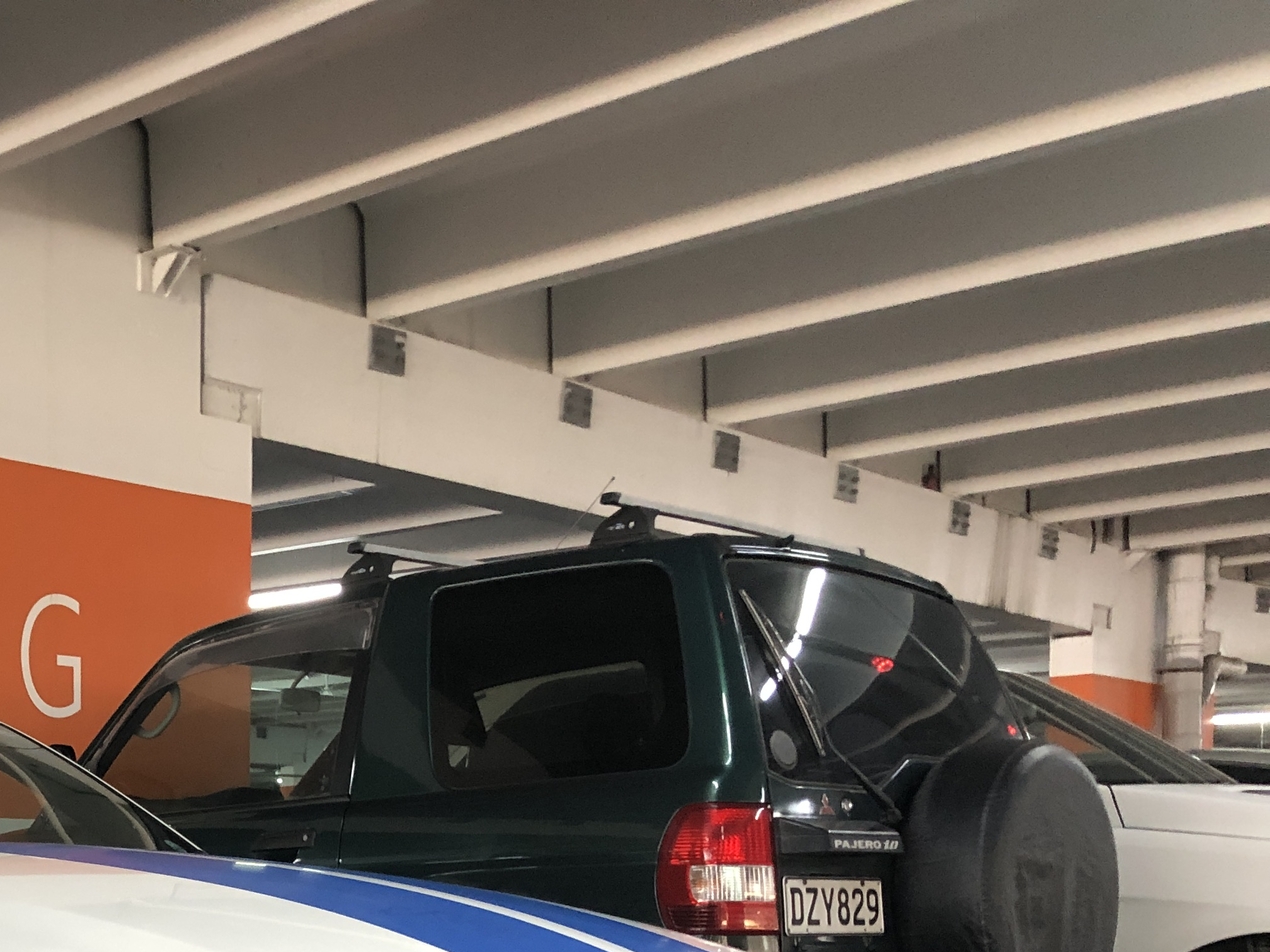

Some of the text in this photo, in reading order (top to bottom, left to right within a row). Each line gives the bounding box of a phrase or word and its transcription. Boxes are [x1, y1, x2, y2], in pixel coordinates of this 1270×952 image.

[20, 593, 82, 719] G
[834, 839, 881, 850] PAJERO
[790, 887, 880, 926] DZY829
